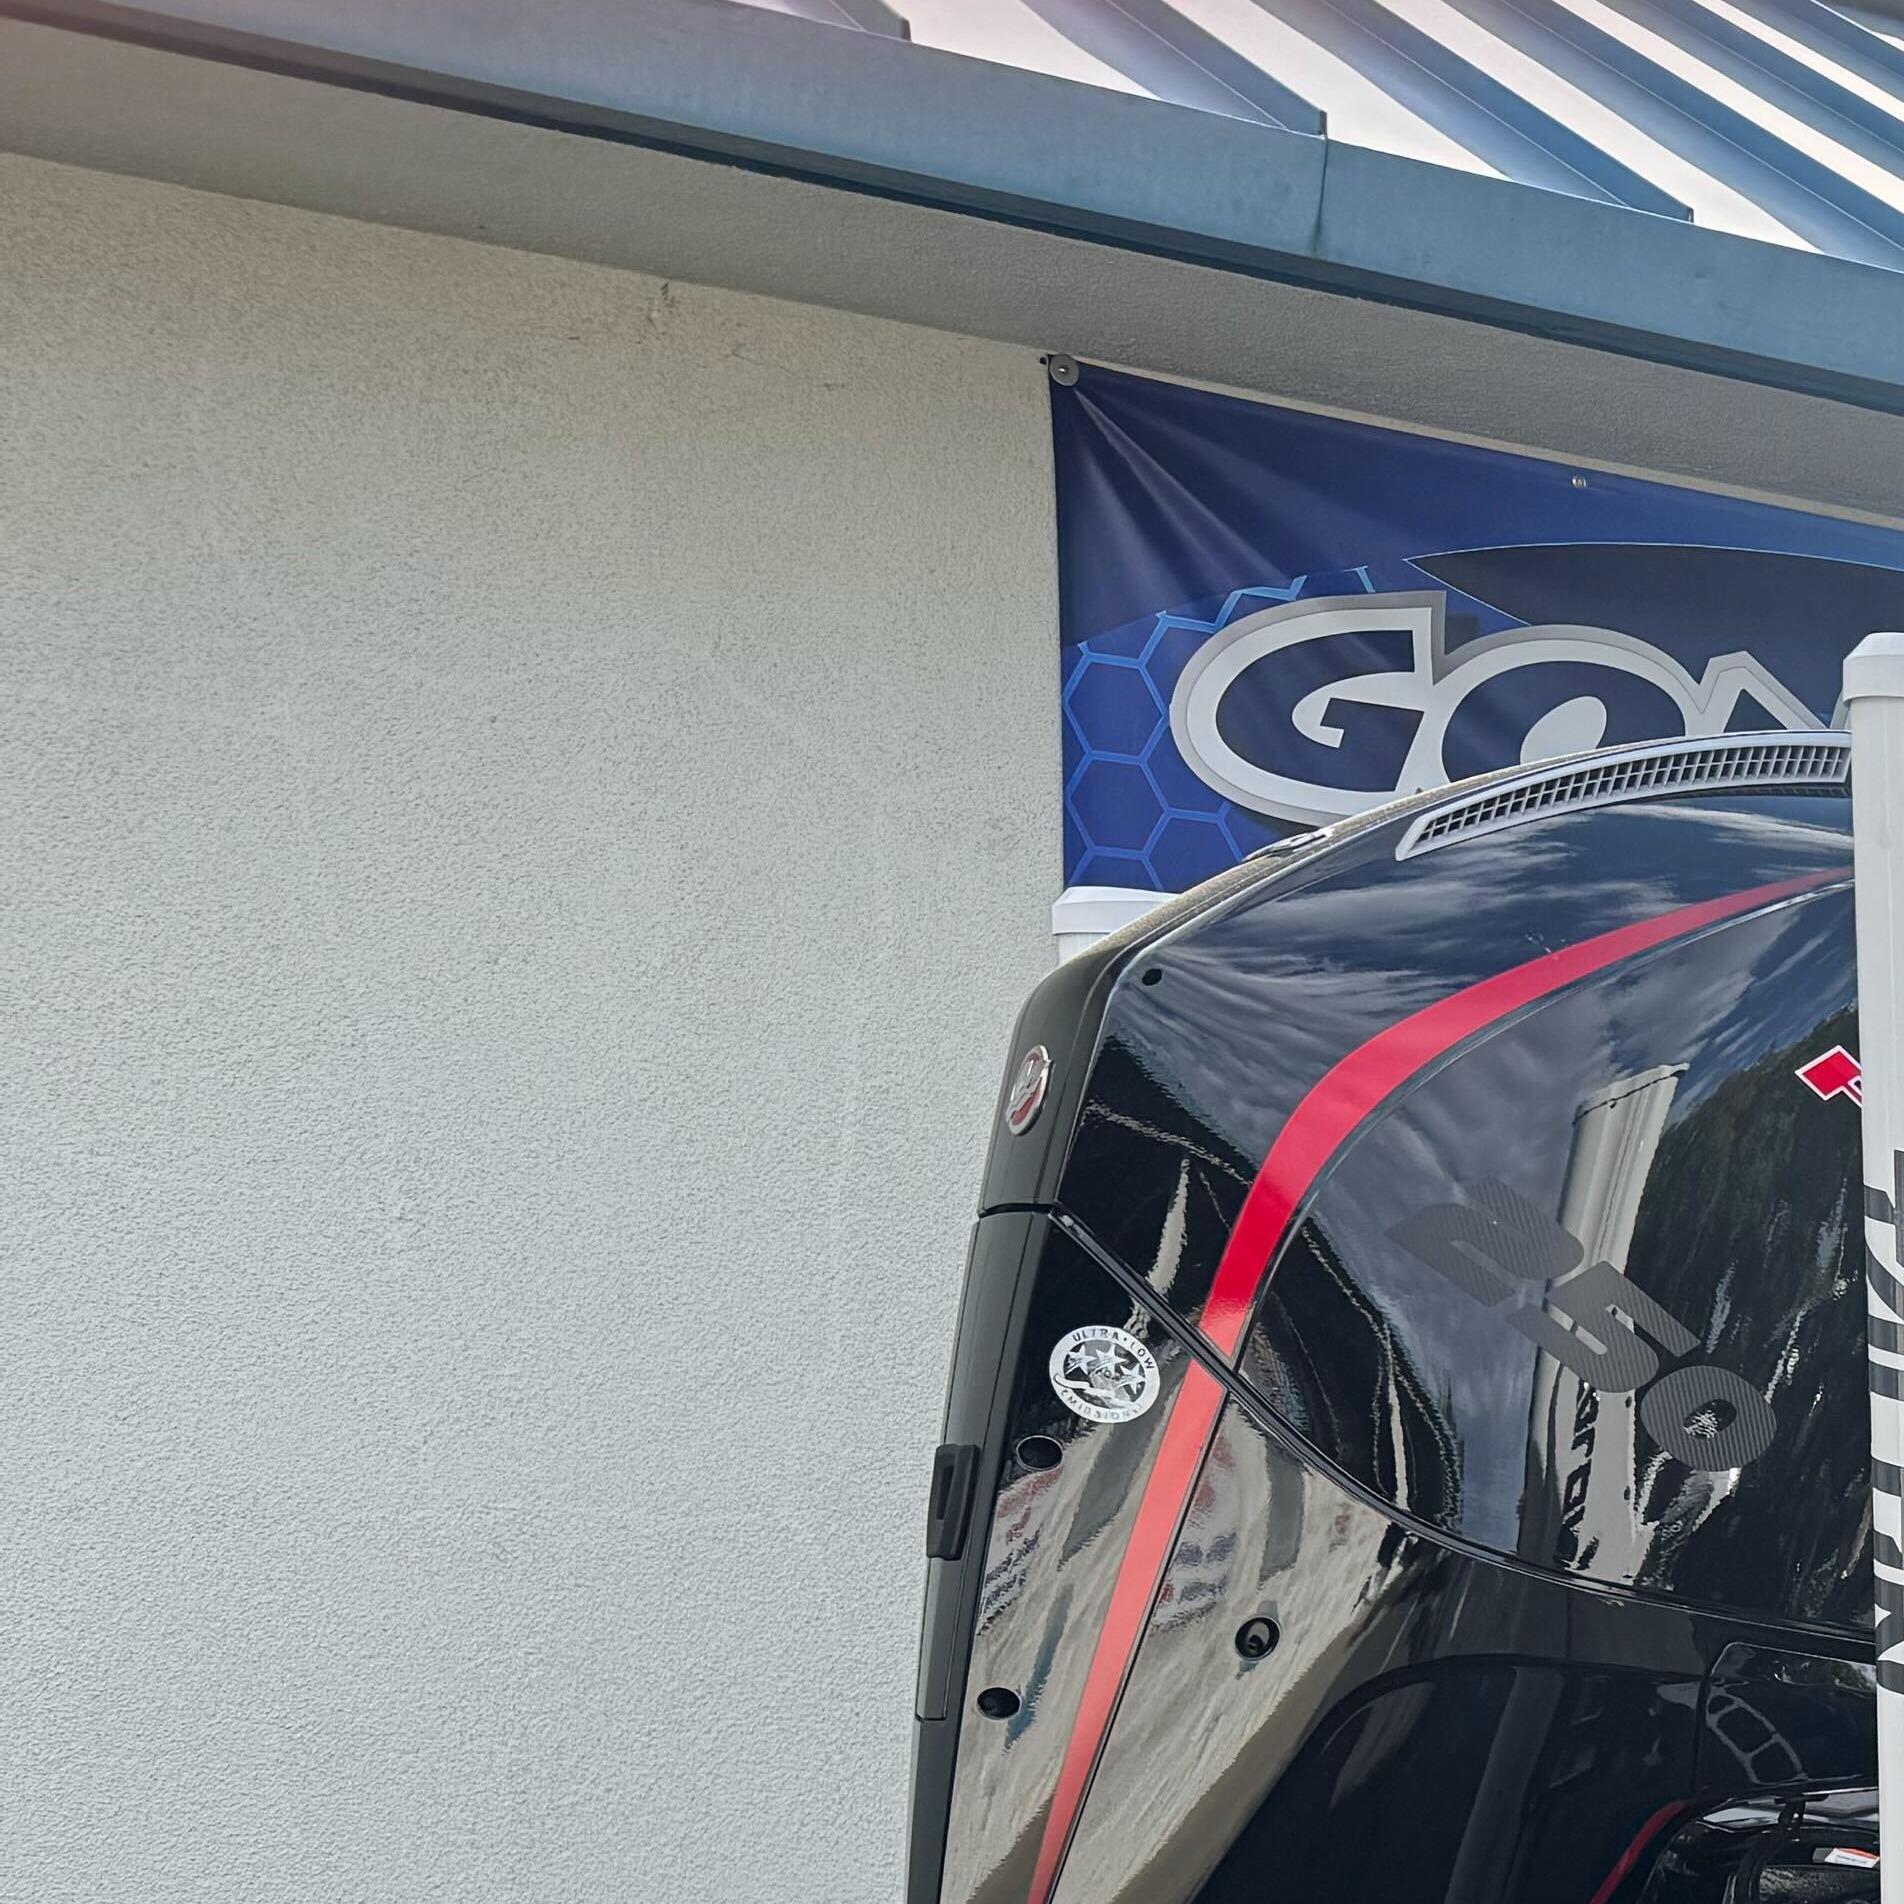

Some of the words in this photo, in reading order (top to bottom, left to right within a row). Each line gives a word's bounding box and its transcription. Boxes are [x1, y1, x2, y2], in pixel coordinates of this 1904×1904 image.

[1180, 600, 1845, 815] GO
[1072, 1328, 1119, 1342] ULTRA
[1129, 1341, 1156, 1369] LOW
[1388, 1177, 1778, 1473] 250
